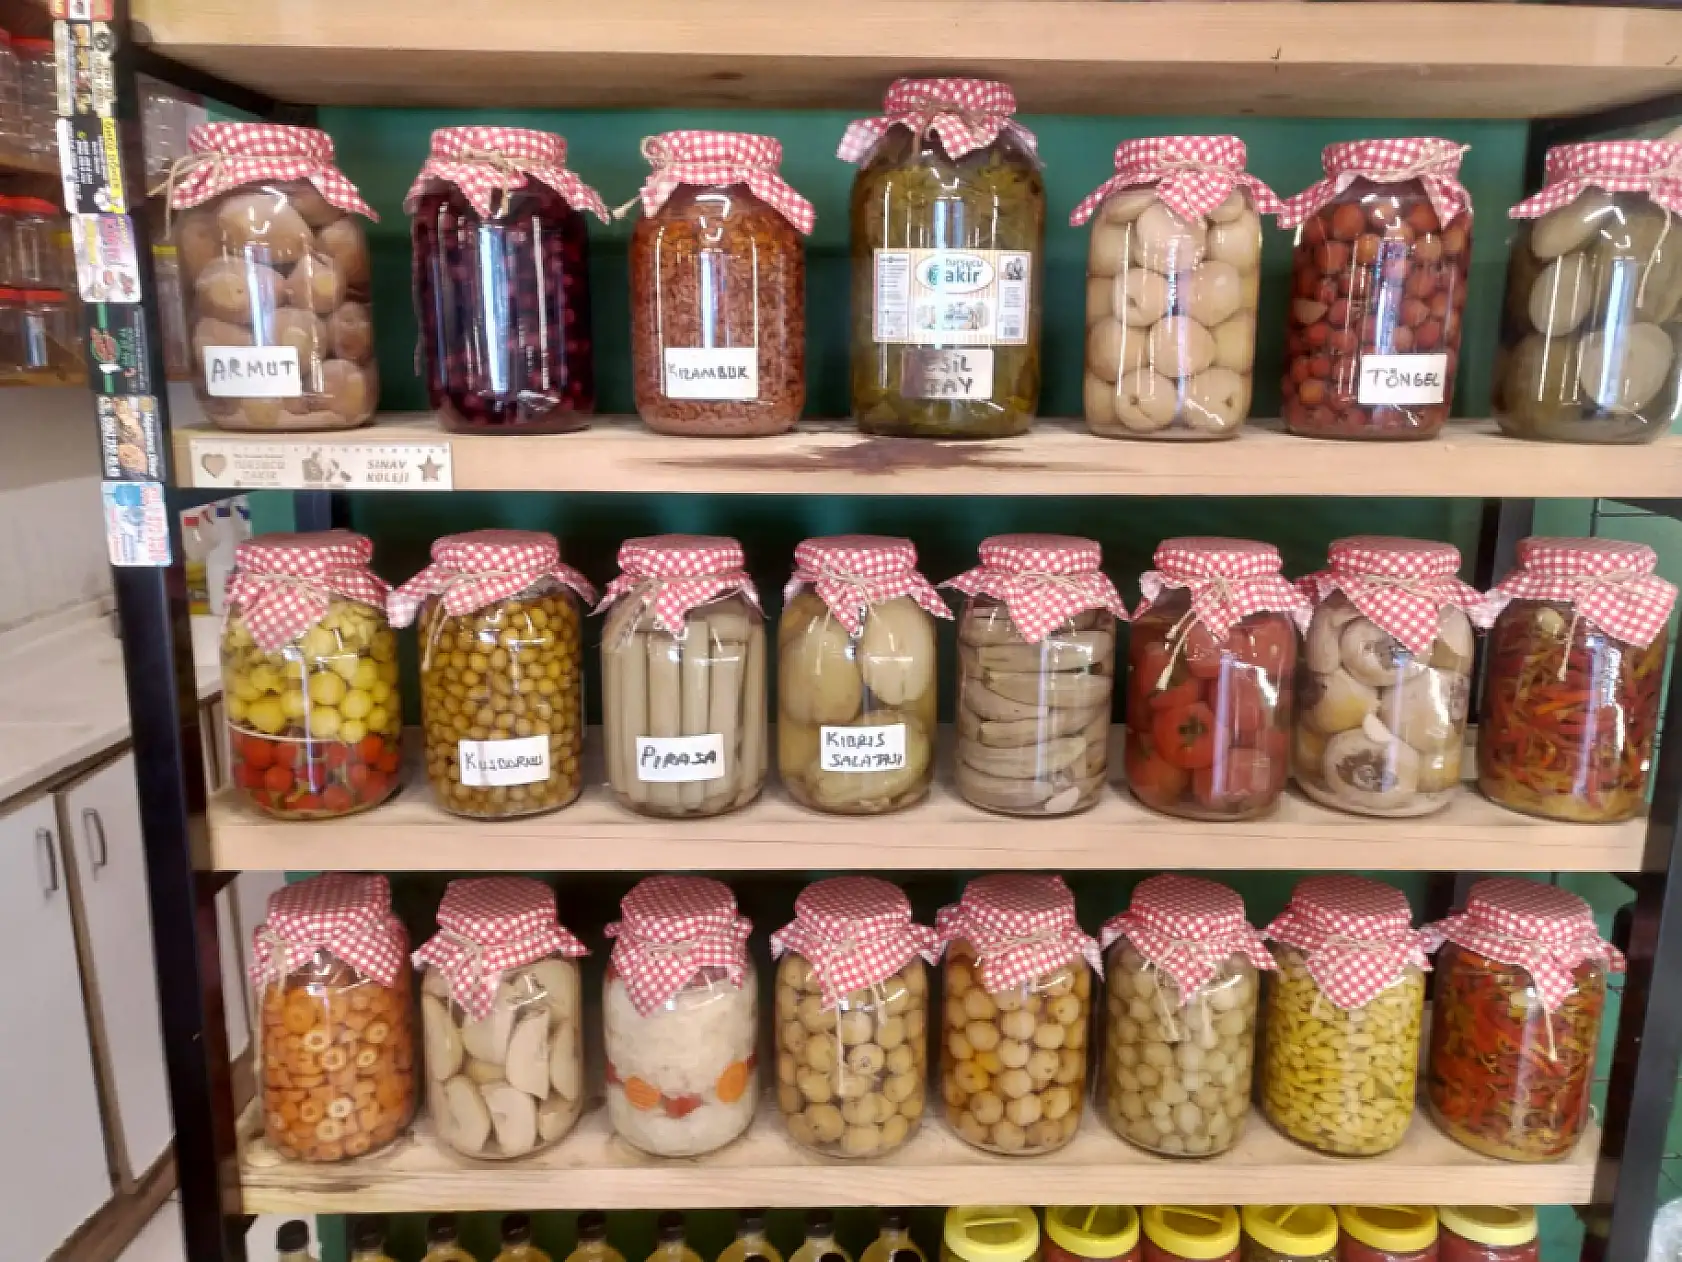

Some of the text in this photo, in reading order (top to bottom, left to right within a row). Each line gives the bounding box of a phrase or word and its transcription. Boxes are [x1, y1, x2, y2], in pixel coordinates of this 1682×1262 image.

[211, 357, 295, 383] ARMUT
[1366, 367, 1441, 388] TÖNGEL
[640, 745, 717, 770] PIRASA
